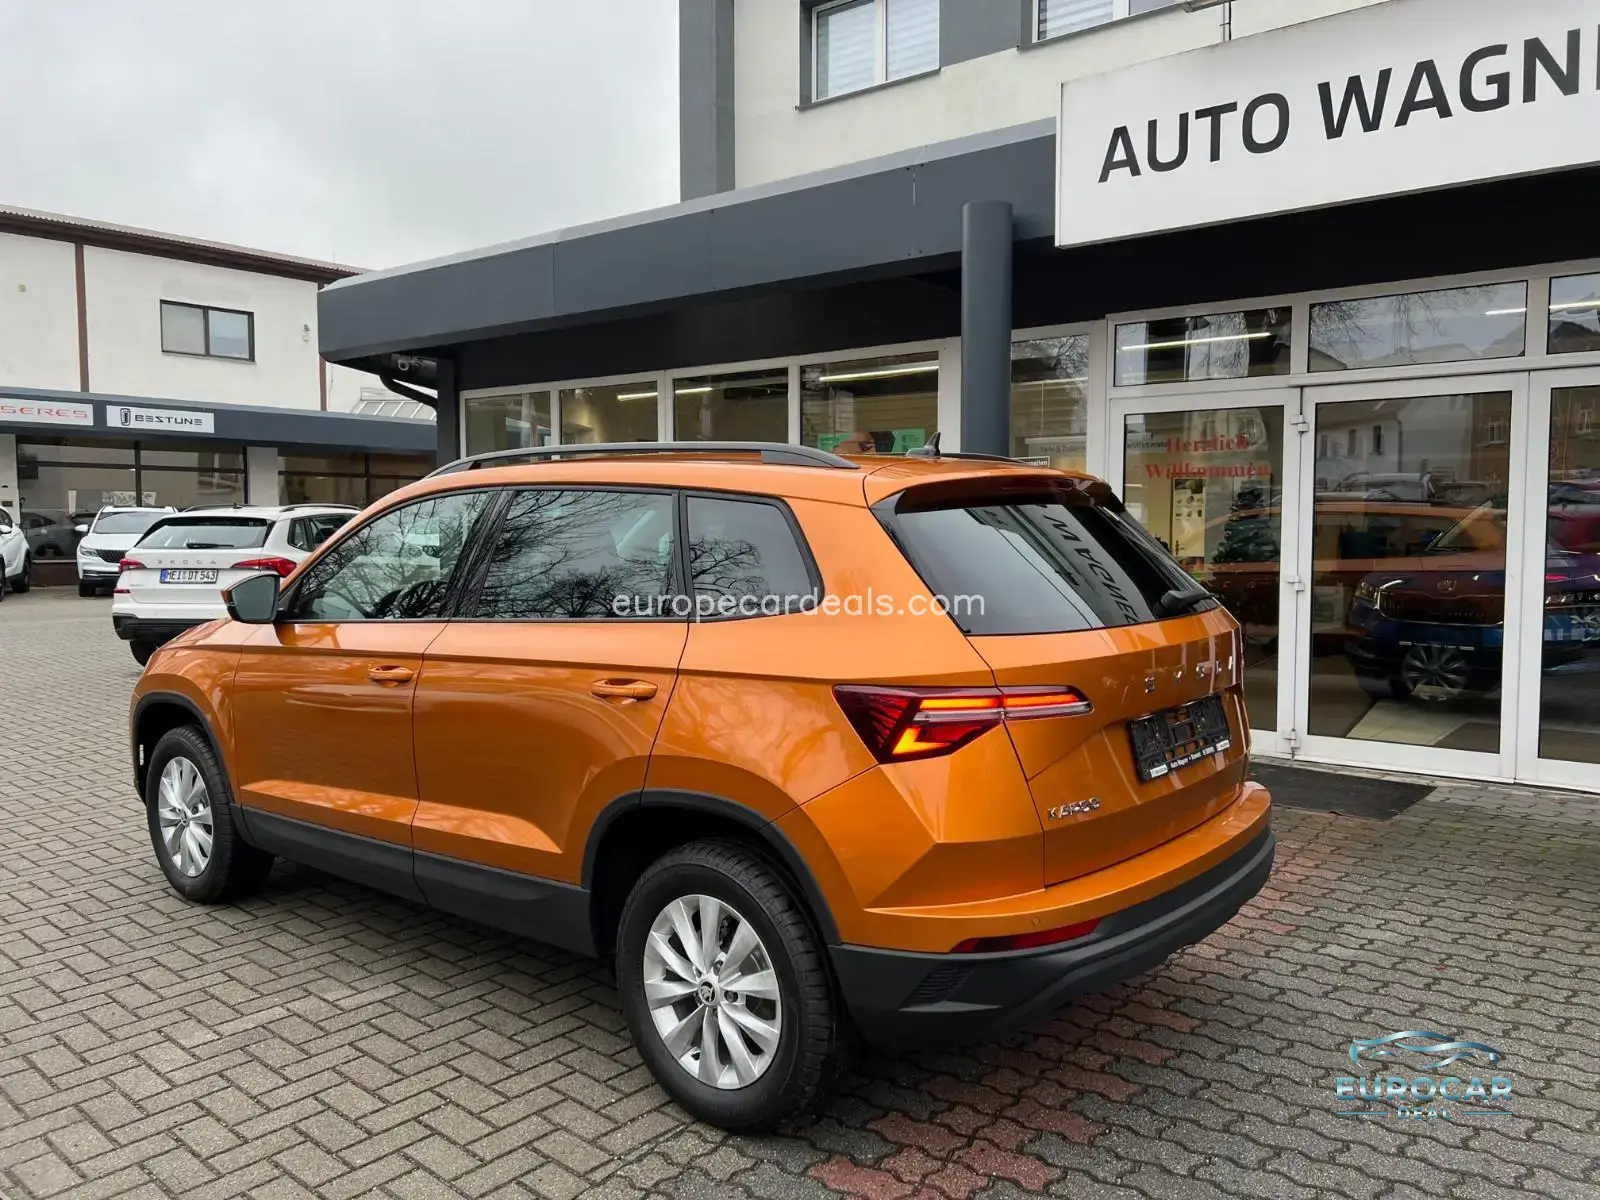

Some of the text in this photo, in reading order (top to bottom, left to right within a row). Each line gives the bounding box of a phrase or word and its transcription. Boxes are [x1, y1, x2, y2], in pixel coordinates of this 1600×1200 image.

[1098, 25, 1600, 183] AUTO WAGN
[1, 405, 88, 419] SERES
[135, 414, 203, 426] BESTUNE
[1166, 434, 1248, 453] Herzlich
[1146, 462, 1271, 478] Willkommen
[167, 570, 216, 581] MEI DT 543
